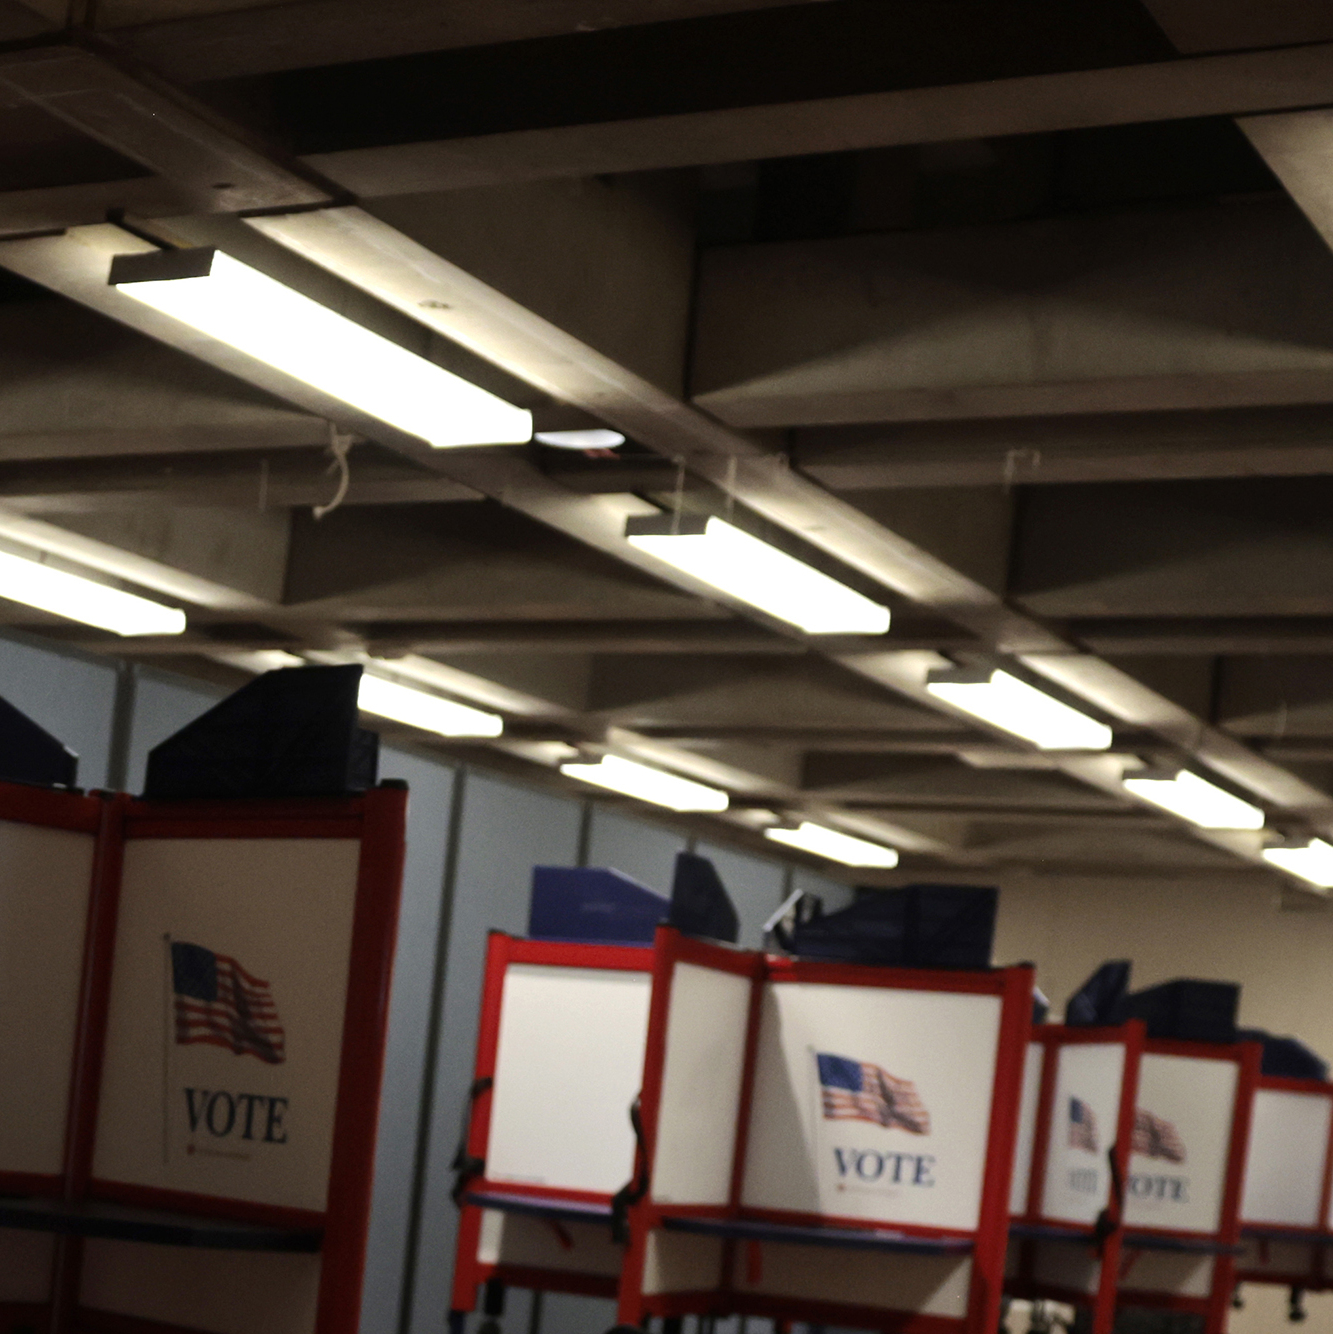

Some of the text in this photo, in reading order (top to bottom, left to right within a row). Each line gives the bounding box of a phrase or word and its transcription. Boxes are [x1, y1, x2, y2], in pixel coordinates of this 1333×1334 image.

[184, 1087, 289, 1144] VOTE
[834, 1148, 936, 1187] VOTE
[1126, 1173, 1188, 1203] OTE
